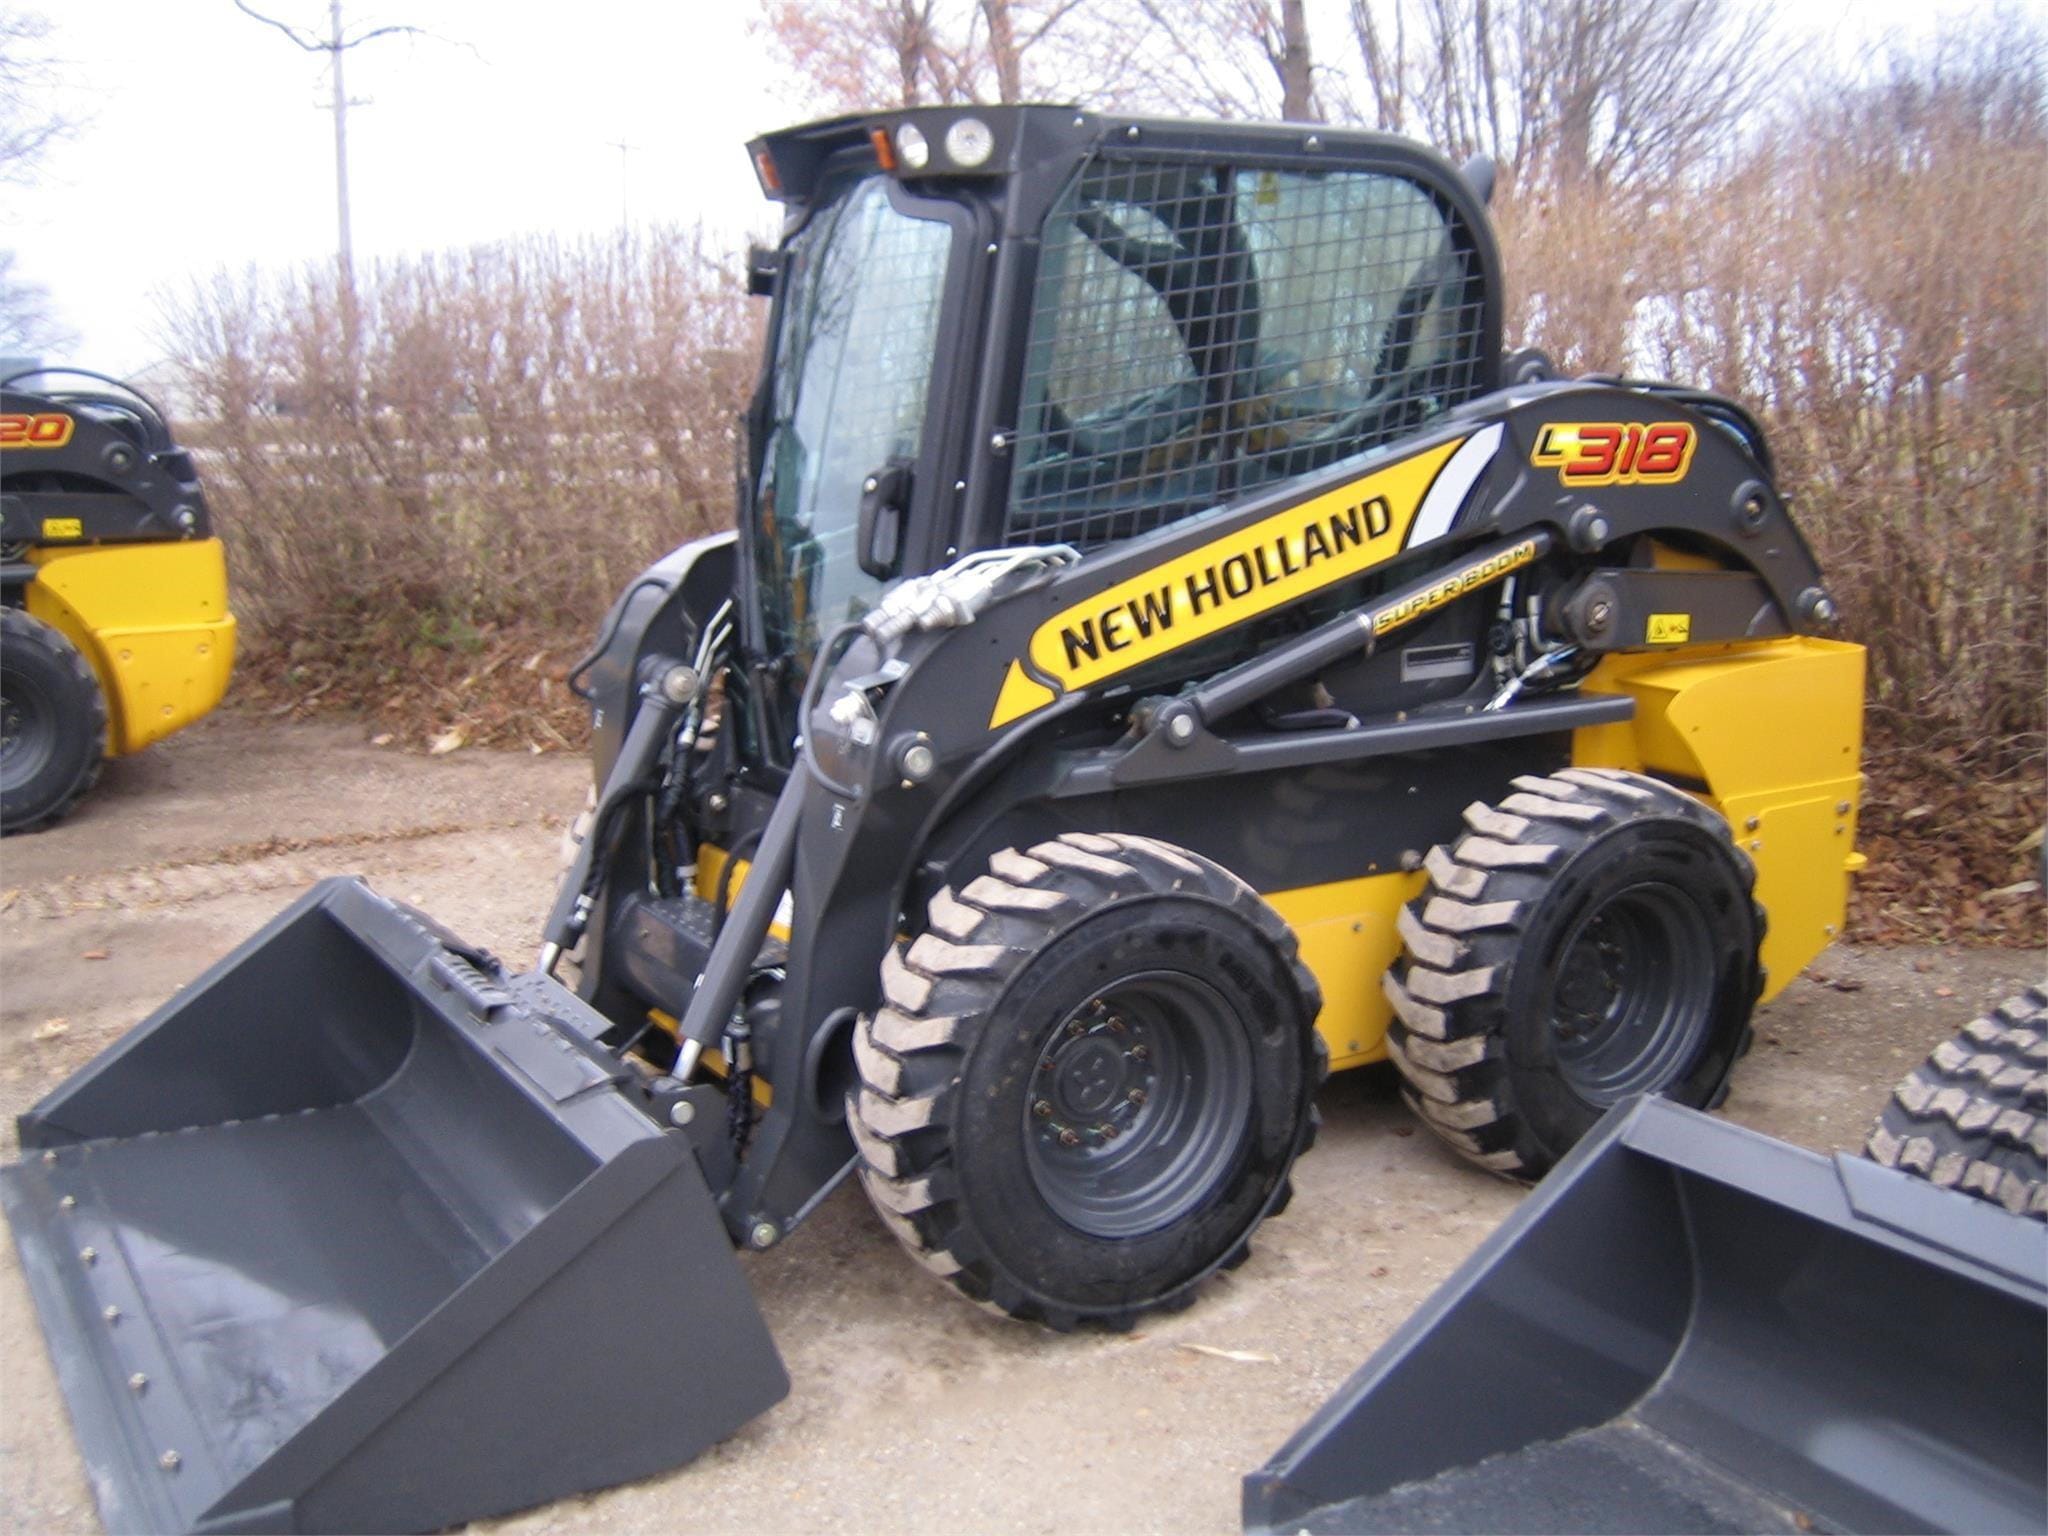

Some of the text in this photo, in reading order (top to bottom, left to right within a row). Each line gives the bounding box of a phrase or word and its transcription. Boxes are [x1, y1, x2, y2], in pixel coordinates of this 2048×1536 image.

[1534, 423, 1693, 481] L318
[1060, 494, 1393, 669] NEW HOLLAND
